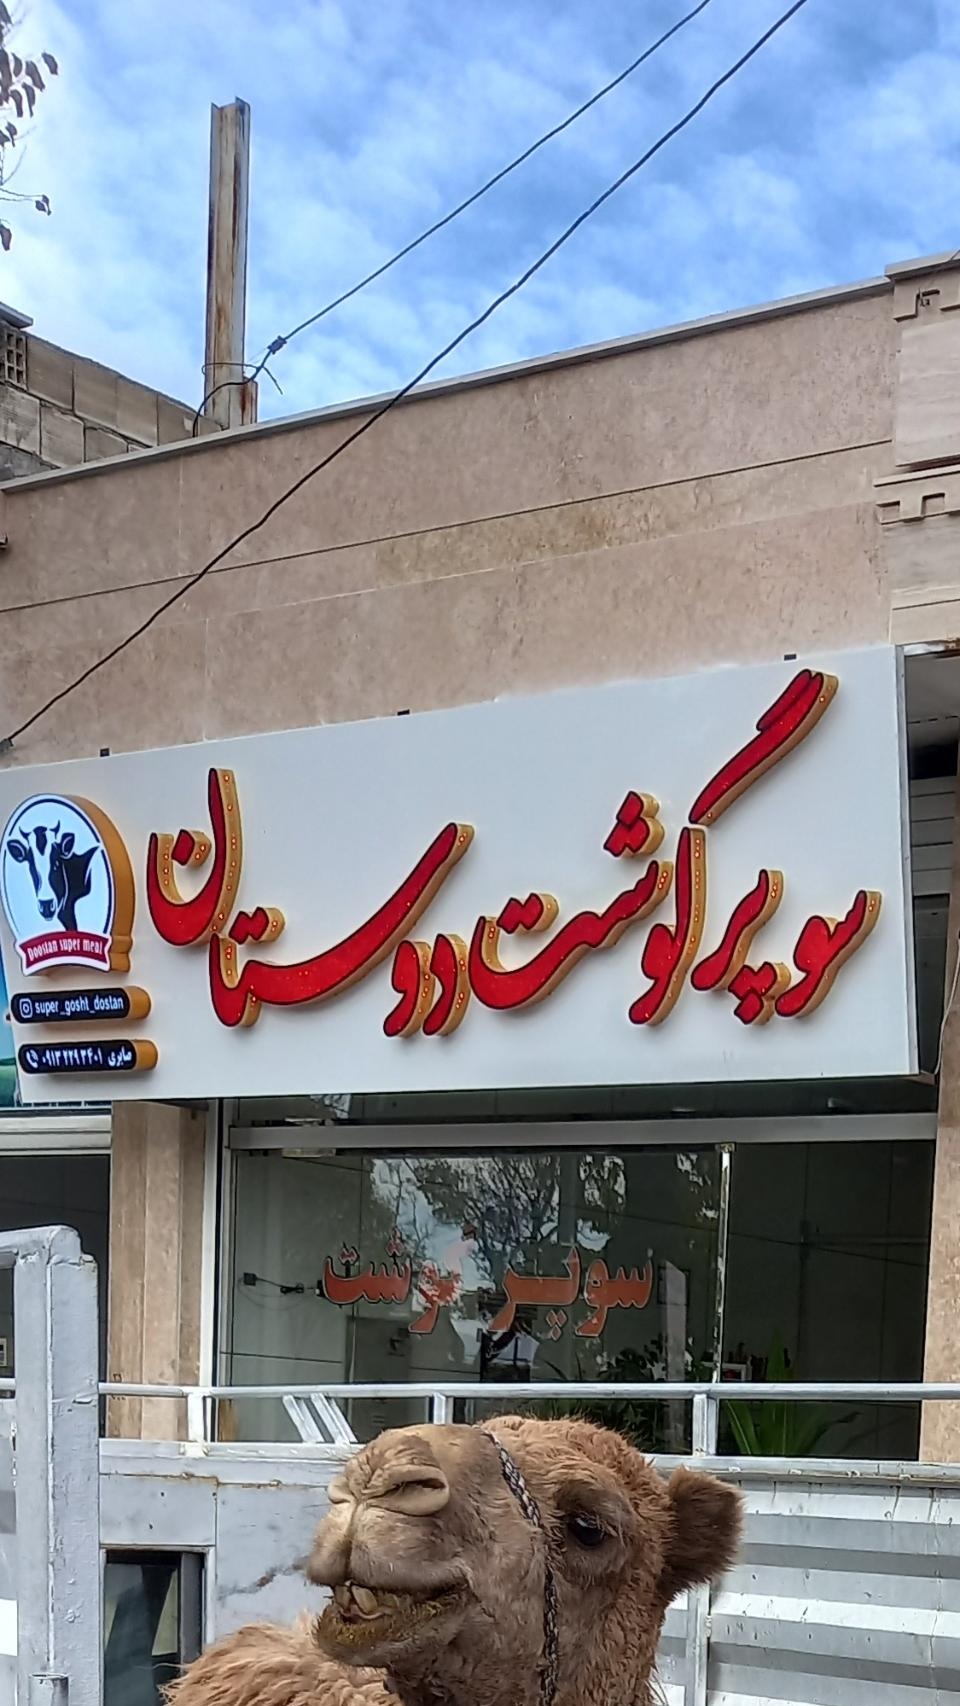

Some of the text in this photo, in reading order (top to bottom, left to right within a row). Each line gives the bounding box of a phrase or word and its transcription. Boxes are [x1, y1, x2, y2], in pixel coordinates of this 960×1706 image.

[146, 668, 882, 1038] سوپر گوشت دوستان
[60, 936, 80, 953] super
[82, 937, 104, 955] meat
[34, 994, 125, 1018] super_gosht_dostan
[487, 1242, 654, 1342] سوپر
